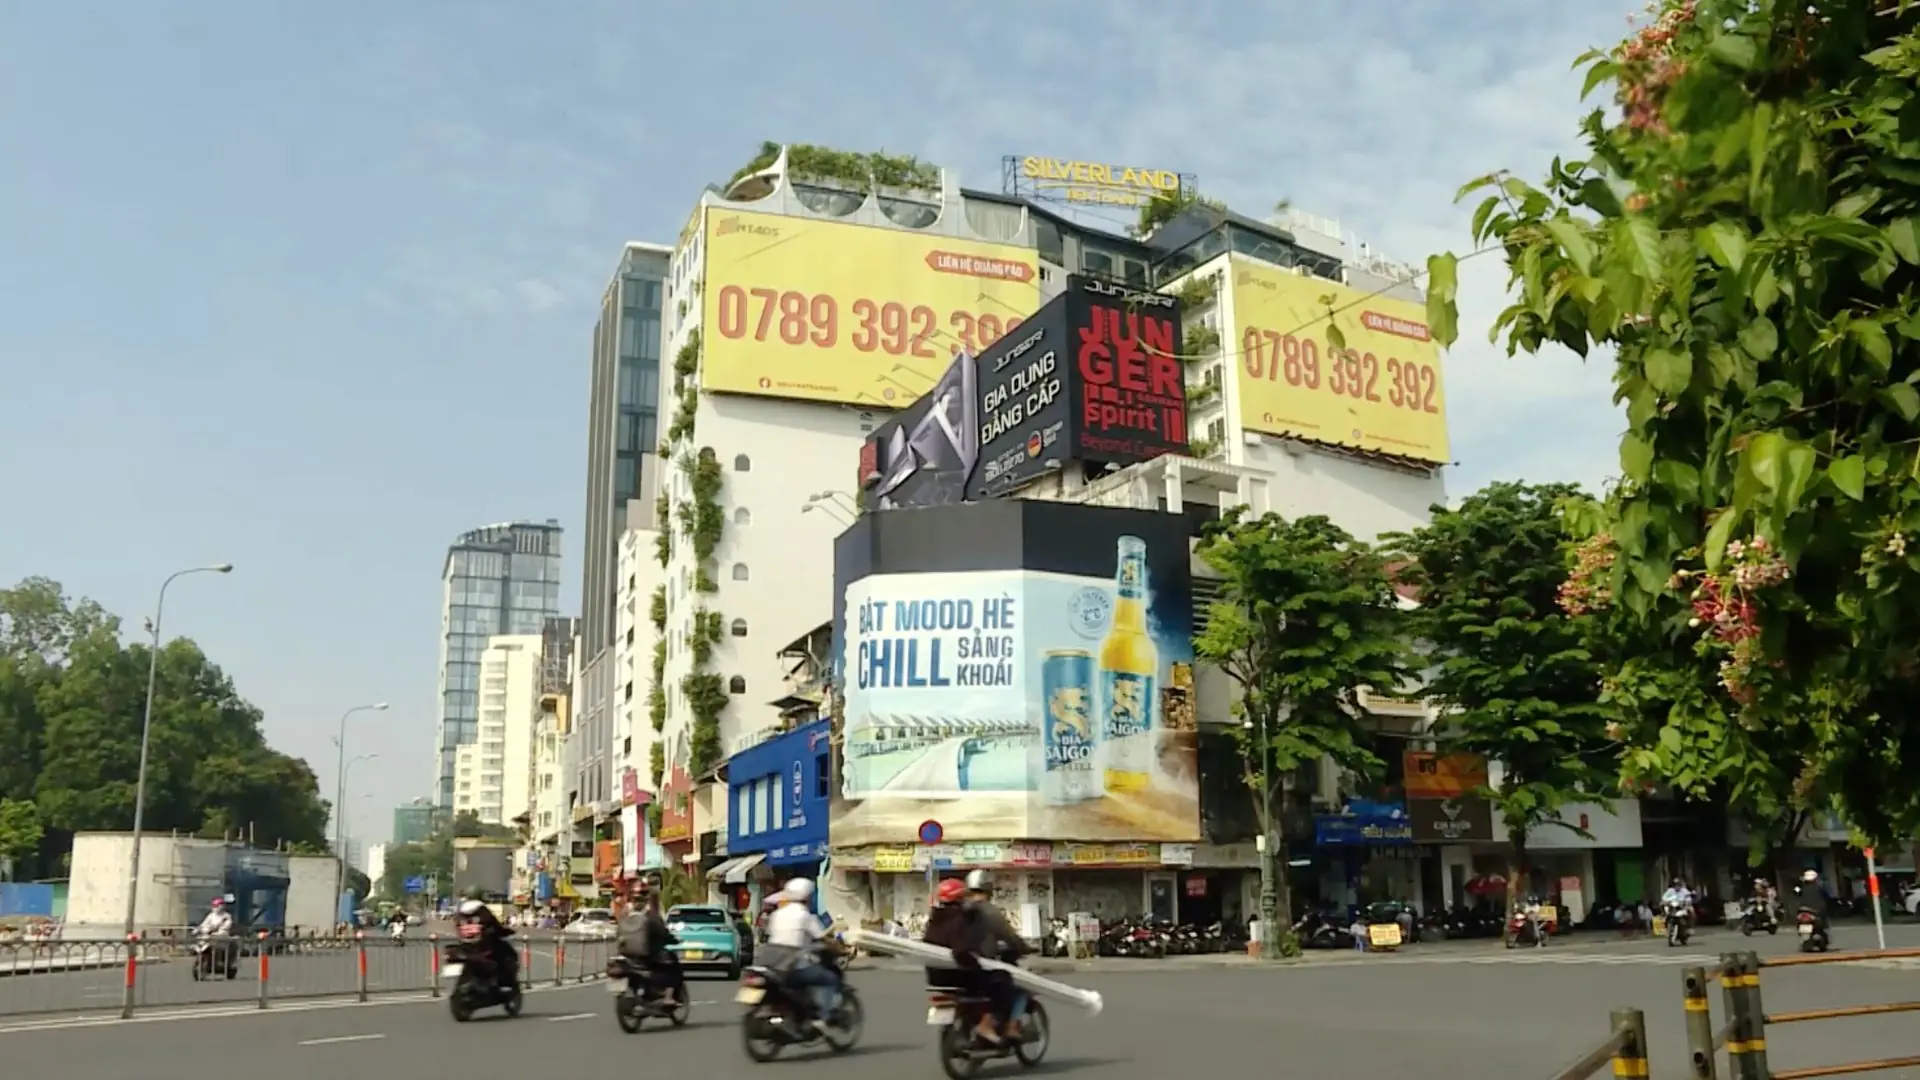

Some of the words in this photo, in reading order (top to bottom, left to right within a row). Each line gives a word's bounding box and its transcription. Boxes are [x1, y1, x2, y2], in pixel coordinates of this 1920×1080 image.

[1023, 156, 1179, 190] SILVERLAND
[719, 285, 838, 348] 0789
[852, 299, 936, 359] 392
[1079, 305, 1173, 352] JUN
[984, 386, 1008, 414] GIA
[1011, 351, 1056, 391] DỤNG
[1079, 343, 1183, 399] GER
[1243, 326, 1320, 390] 0789
[1327, 346, 1381, 403] 392
[1387, 358, 1438, 414] 392
[1027, 378, 1060, 417] CẤP
[1087, 402, 1157, 431] spirit
[895, 599, 973, 631] MOOD
[982, 591, 1015, 629] HÈ
[858, 637, 951, 690] CHILL
[957, 627, 1014, 659] SẢNG
[956, 656, 1013, 687] KHOÁI
